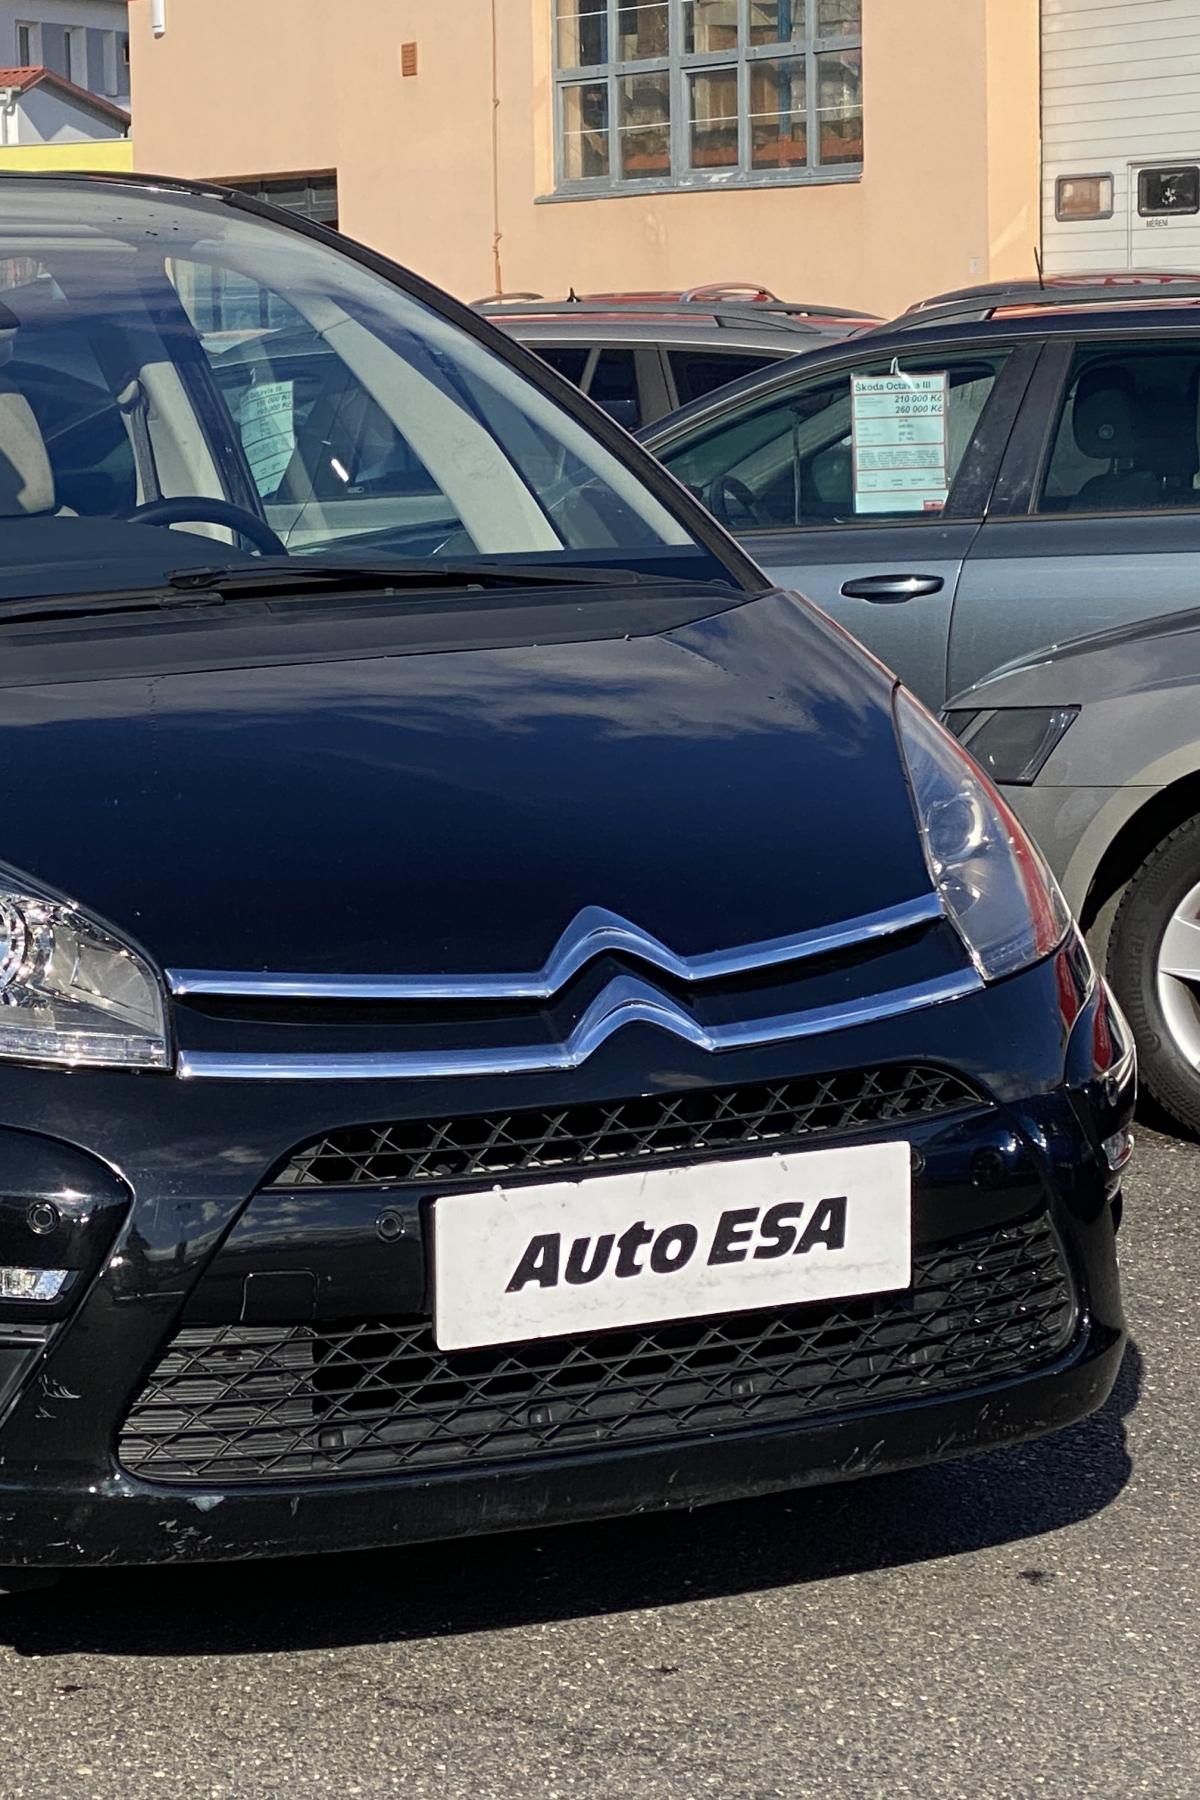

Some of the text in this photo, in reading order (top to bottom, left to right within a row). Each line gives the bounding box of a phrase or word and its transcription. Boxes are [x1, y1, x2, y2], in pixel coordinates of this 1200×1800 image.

[855, 381, 931, 392] Škoda Octava III
[895, 406, 910, 414] 260
[912, 405, 928, 413] 000
[506, 1197, 847, 1292] Auto ESA
